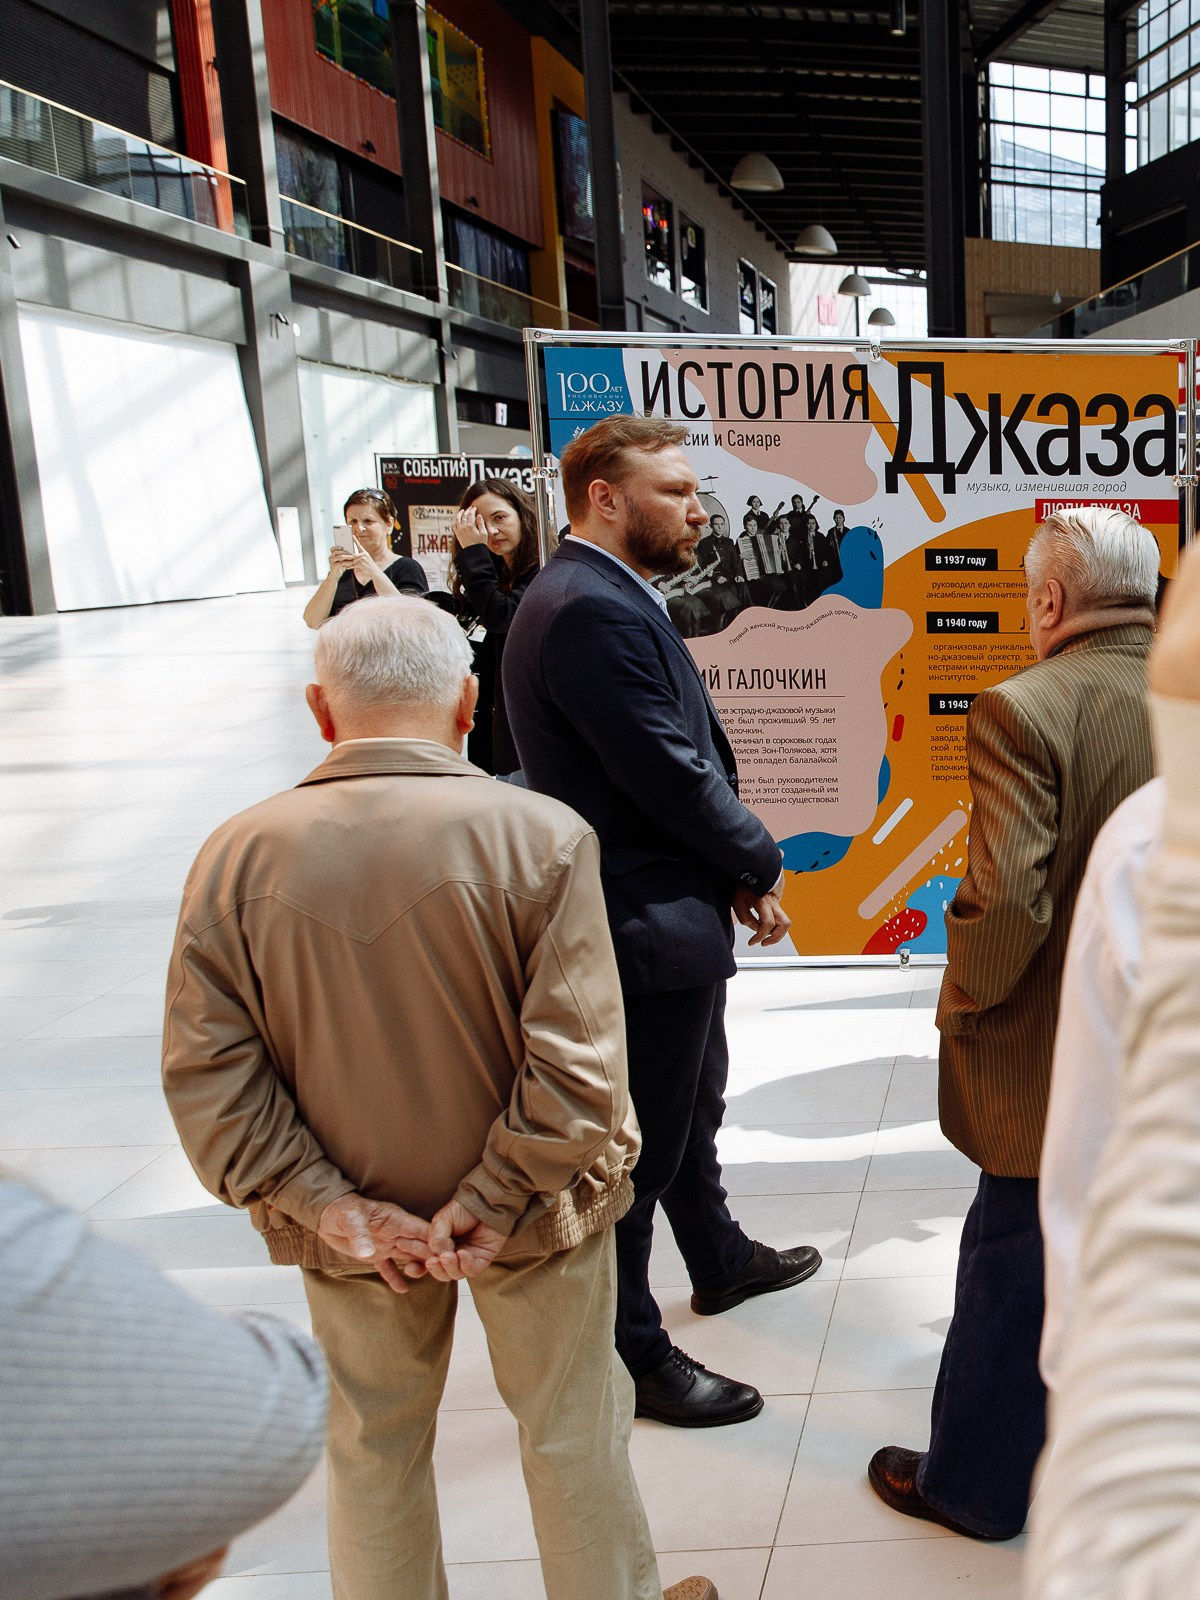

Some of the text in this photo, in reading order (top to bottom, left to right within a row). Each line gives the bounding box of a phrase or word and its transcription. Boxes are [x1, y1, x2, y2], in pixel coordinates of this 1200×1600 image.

[556, 372, 611, 412] 100
[569, 400, 625, 412] ДЖАЗУ
[641, 360, 1178, 494] ИСТОРИЯ Джаза
[680, 429, 781, 451] сии и Самаре
[403, 458, 469, 477] СОБЫТИЯ
[966, 481, 1127, 495] музыка, изменившая город
[935, 556, 987, 566] В 1937 году
[931, 582, 975, 590] руководил
[926, 591, 972, 599] ансамблем
[728, 609, 858, 646] Первый женский эстрадно-джазовый оркестр
[937, 619, 987, 629] В 1940 году
[933, 644, 987, 652] организовал
[928, 653, 984, 661] но-джазовый
[987, 654, 1022, 662] оркестр,
[928, 664, 968, 672] кестрами
[727, 668, 827, 690] ГАЛОЧКИН
[928, 674, 978, 682] институтов.
[939, 700, 946, 709] В
[947, 700, 969, 709] 1943
[730, 707, 804, 716] эстрадно-джазовой
[805, 707, 836, 716] музыки
[737, 716, 754, 724] был
[758, 716, 806, 725] проживший
[726, 727, 765, 735] Галочкин.
[935, 724, 964, 733] собрал
[772, 737, 813, 746] сороковых
[815, 737, 837, 745] годах
[761, 746, 818, 755] Зон-Полякова,
[930, 744, 950, 752] ской
[753, 757, 788, 765] овладел
[789, 756, 838, 764] балалайкой
[758, 776, 775, 784] был
[777, 777, 838, 786] руководителем
[762, 787, 779, 795] этот
[780, 786, 825, 795] созданный
[751, 797, 788, 806] успешно
[788, 797, 839, 806] существовал
